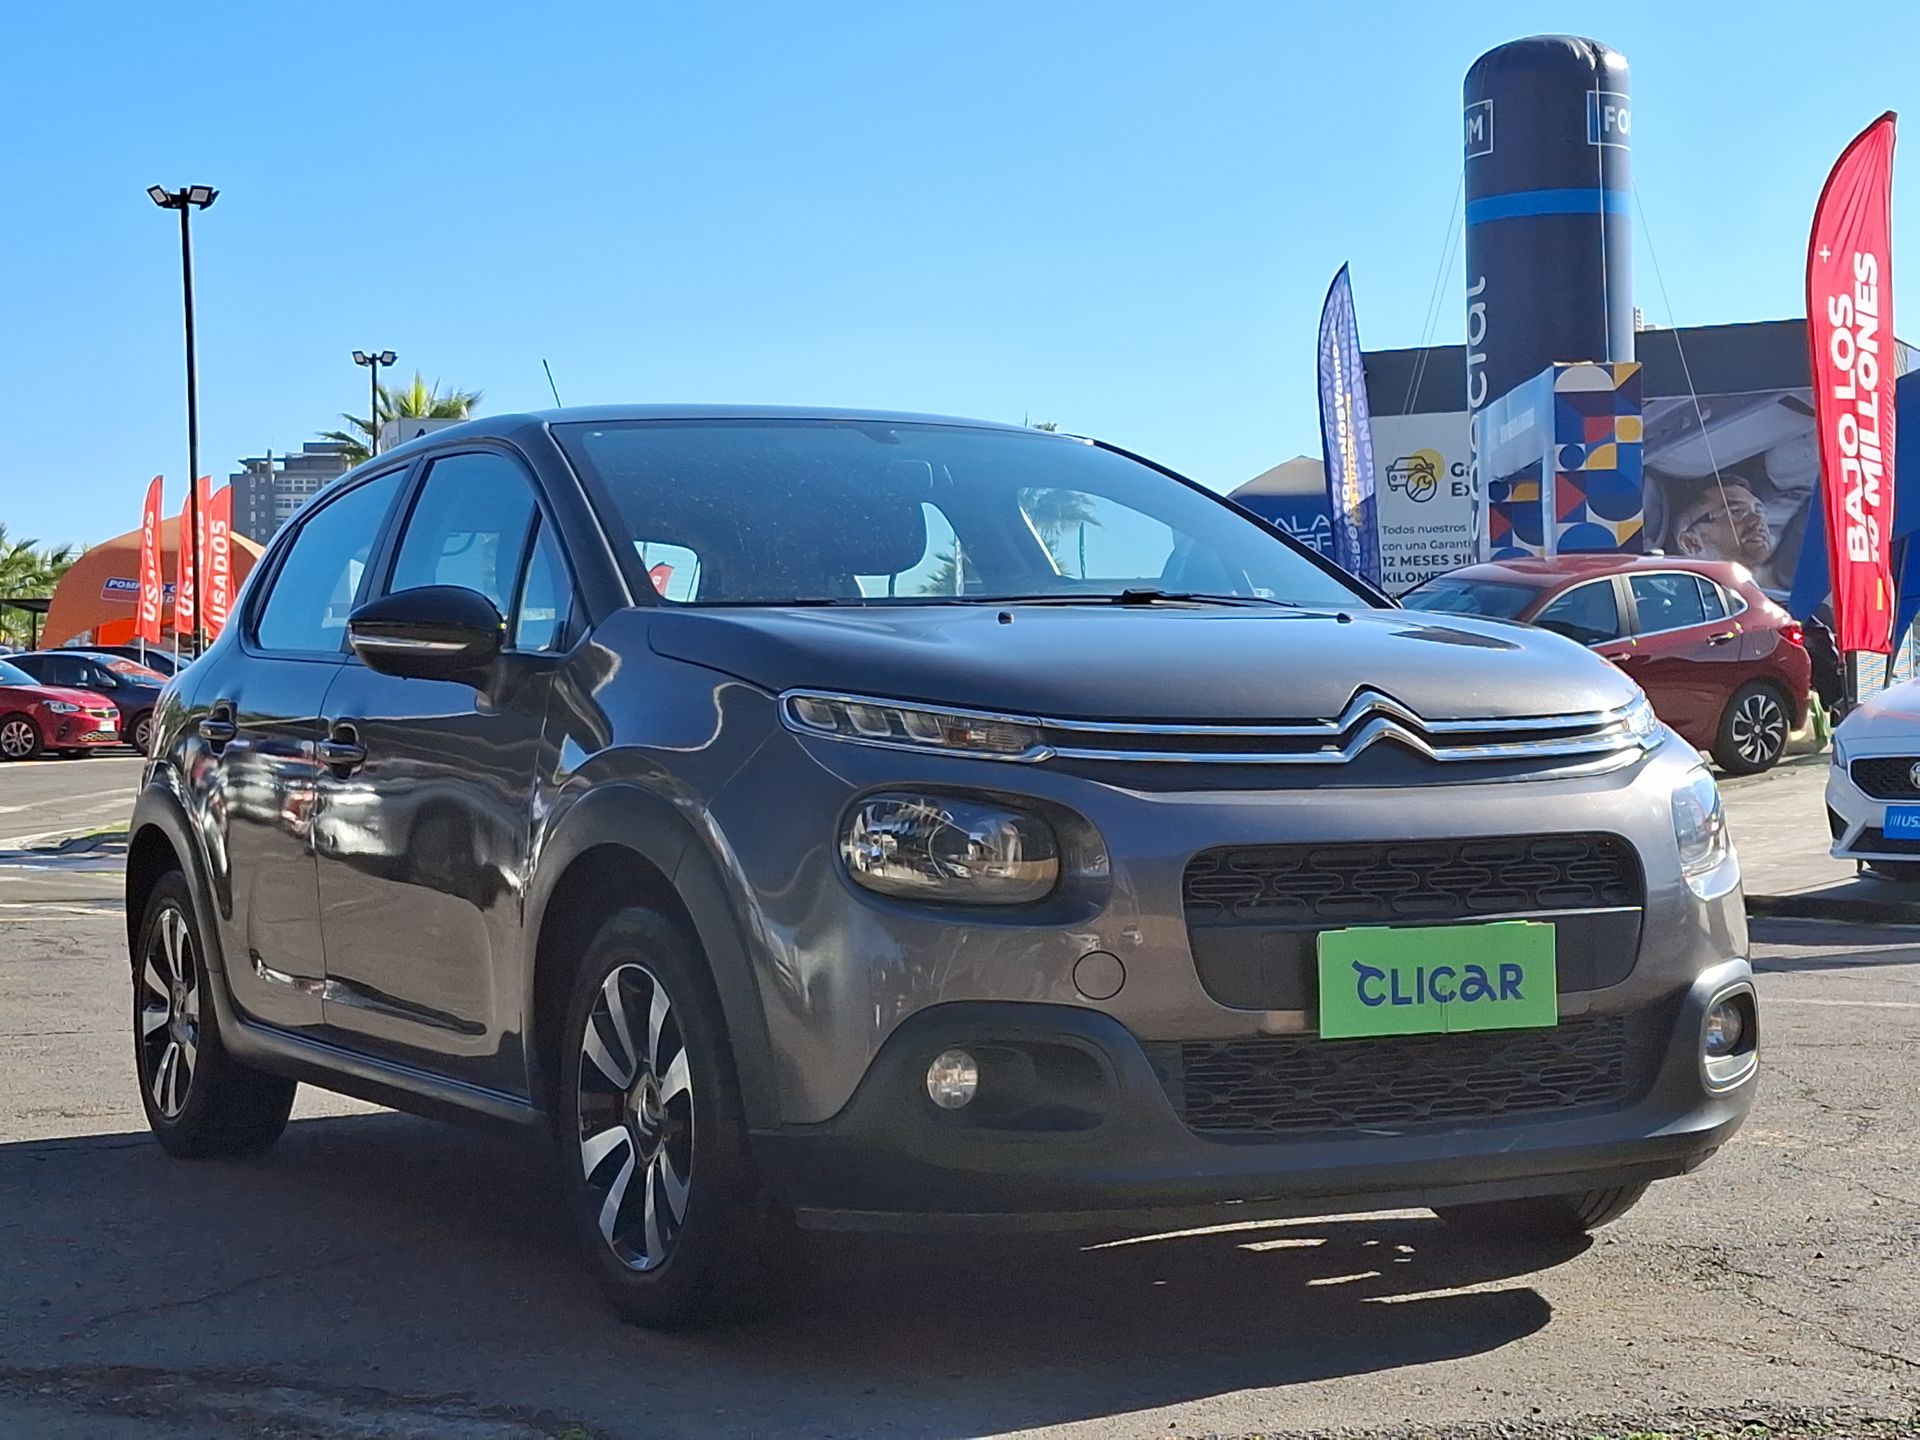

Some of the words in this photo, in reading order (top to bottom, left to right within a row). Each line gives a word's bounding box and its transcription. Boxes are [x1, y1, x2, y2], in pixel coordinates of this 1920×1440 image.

[1604, 105, 1632, 137] FO
[1828, 293, 1856, 400] LOS
[1854, 251, 1883, 507] MILLONES
[1838, 413, 1871, 562] BAJO
[1382, 525, 1415, 536] Todos
[1418, 524, 1467, 534] nuestros
[1382, 542, 1403, 551] con
[1406, 541, 1427, 551] una
[1382, 556, 1396, 567] 12
[1400, 554, 1450, 567] MESES
[211, 520, 228, 624] USADOS
